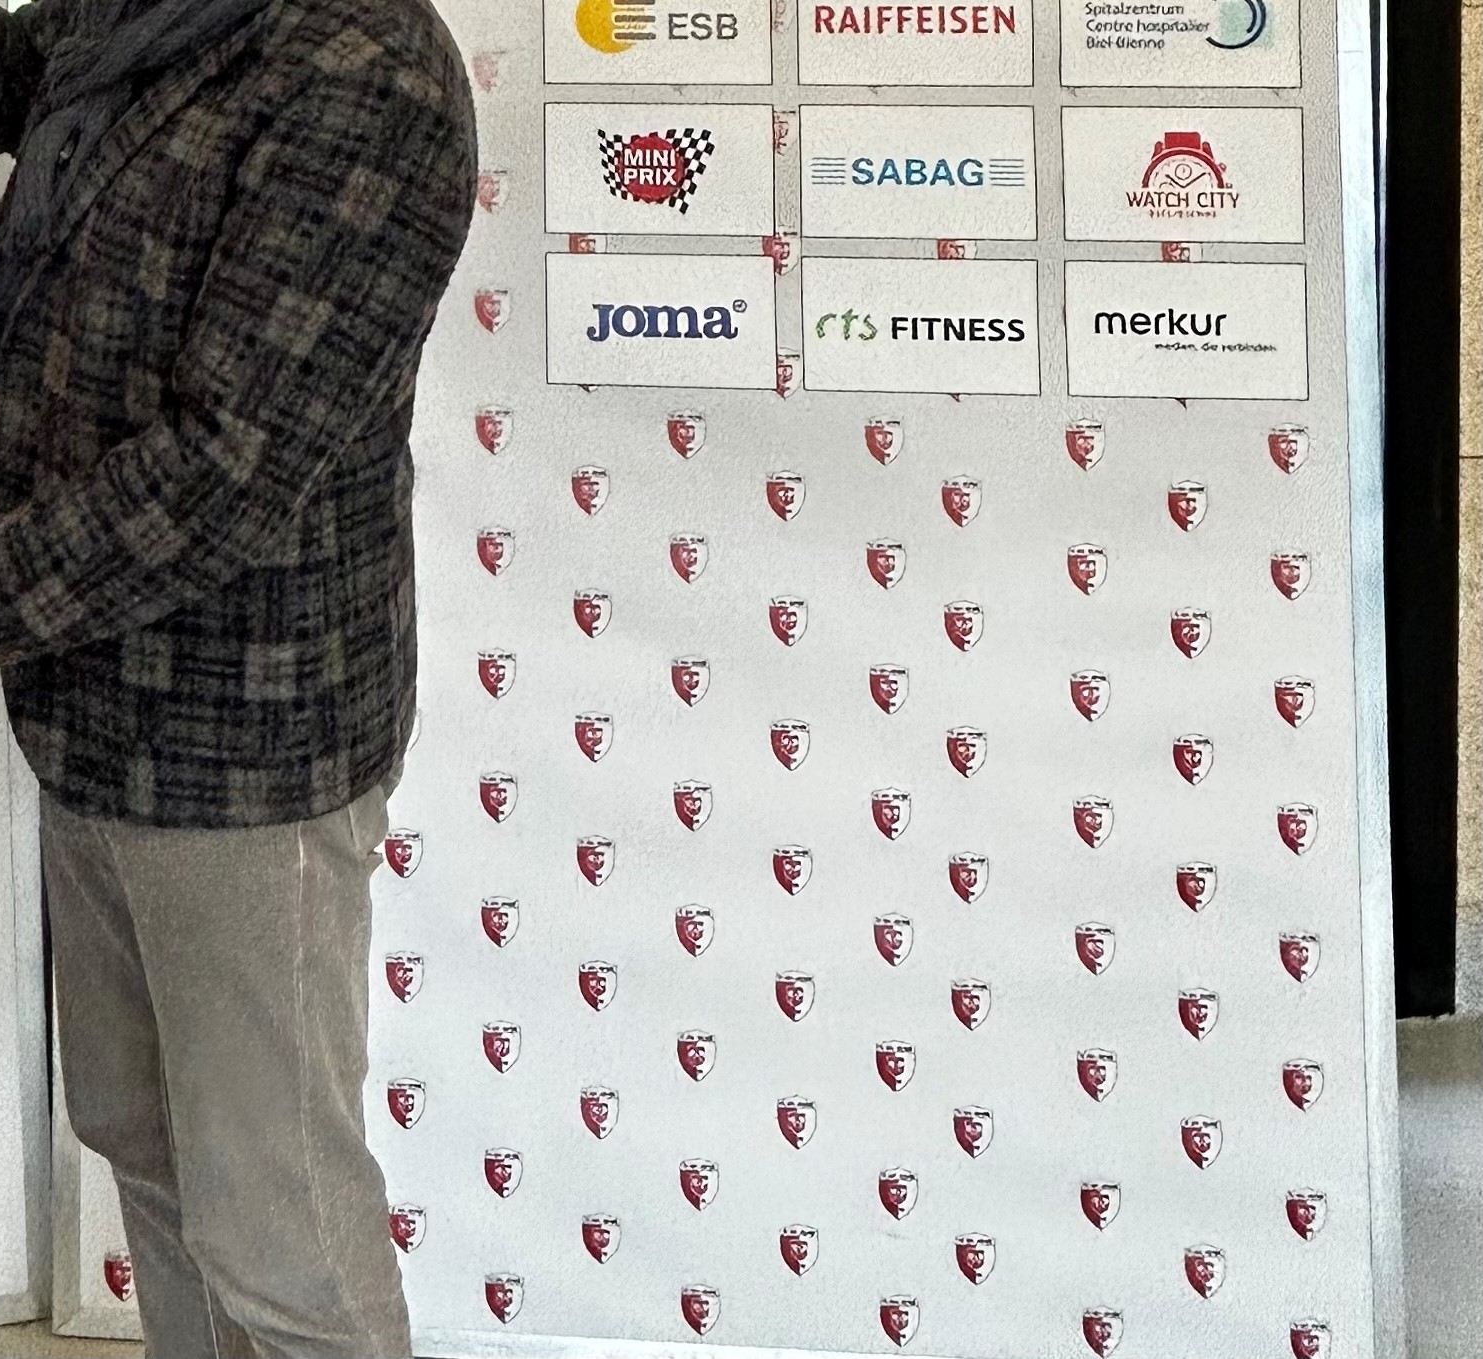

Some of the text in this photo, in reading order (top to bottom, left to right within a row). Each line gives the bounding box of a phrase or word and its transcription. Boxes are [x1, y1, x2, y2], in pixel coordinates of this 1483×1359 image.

[668, 14, 738, 40] ESB
[814, 5, 1016, 35] RAIFFEISEN
[624, 148, 677, 167] MINI
[624, 167, 677, 186] PRIX
[851, 158, 984, 187] SABAG
[1126, 192, 1239, 208] WATCH CITY
[891, 317, 1025, 341] FITNESS
[1094, 308, 1227, 336] merkur
